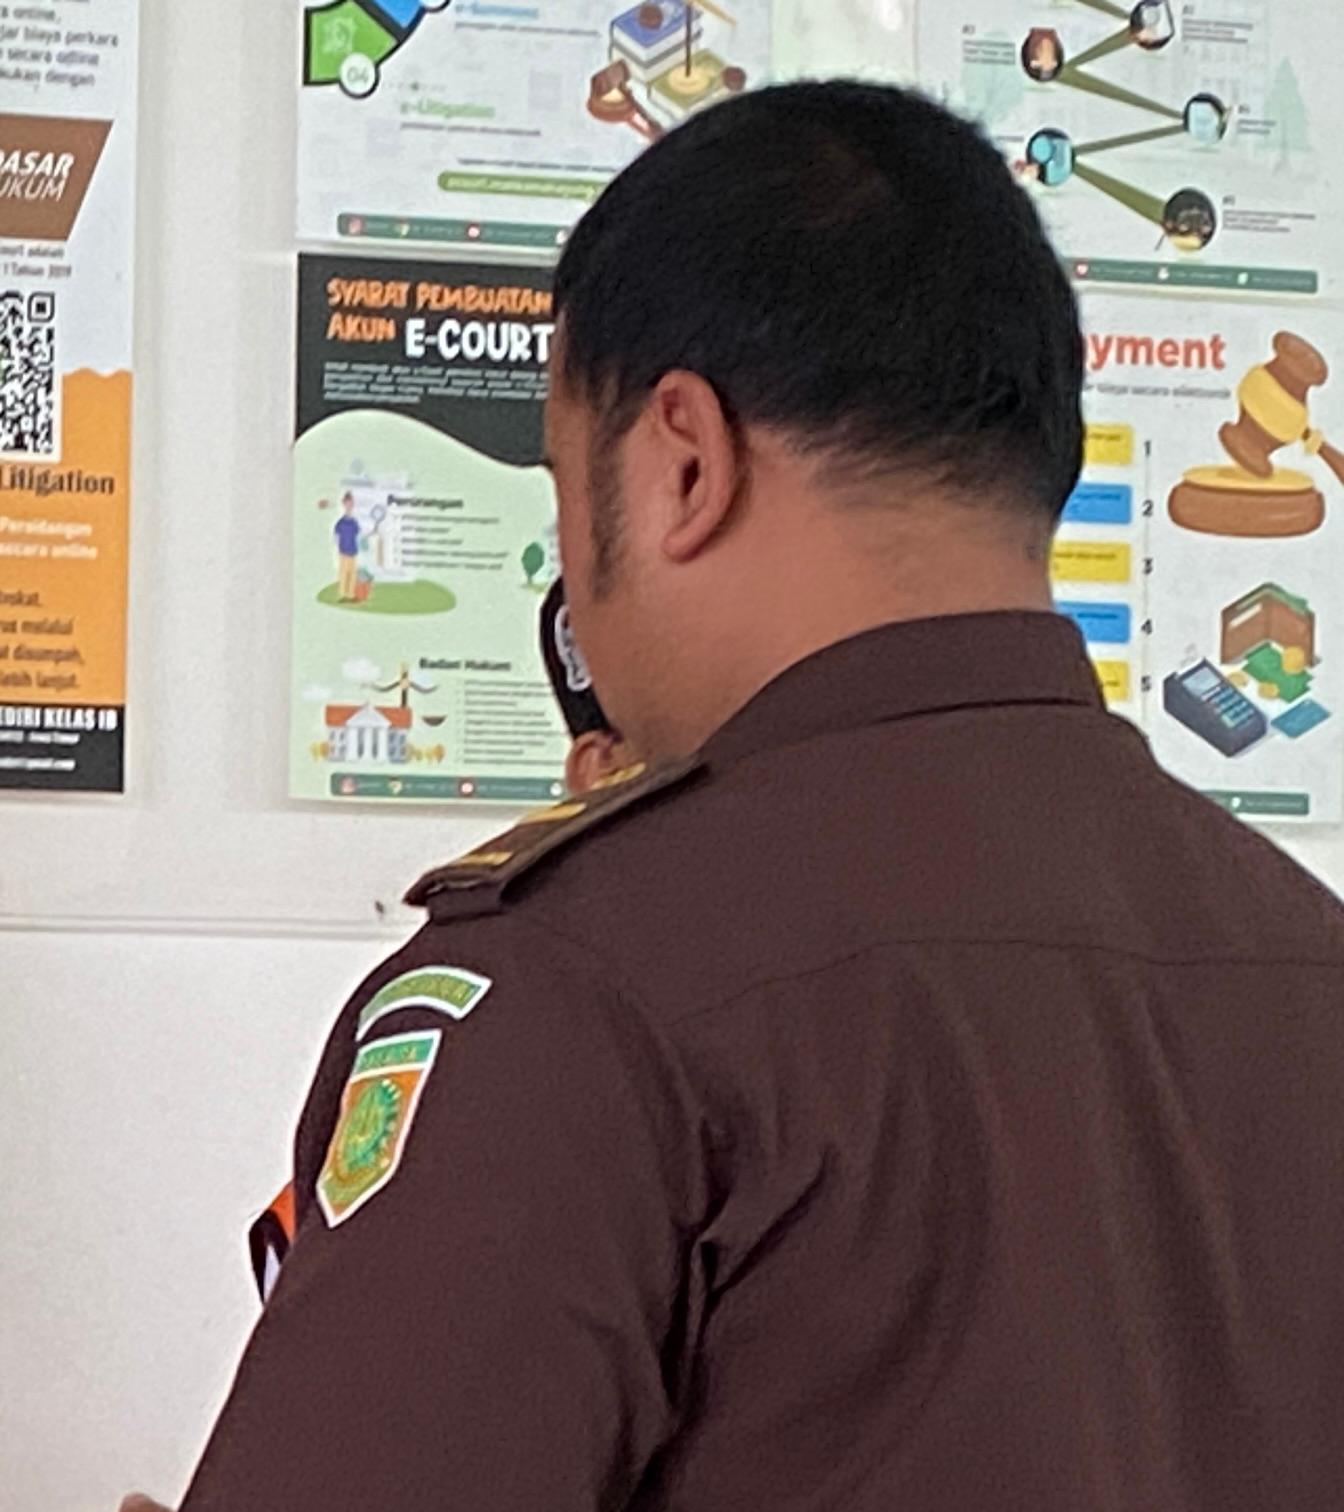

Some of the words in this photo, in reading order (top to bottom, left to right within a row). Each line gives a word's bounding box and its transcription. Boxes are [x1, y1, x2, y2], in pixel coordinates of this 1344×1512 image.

[326, 277, 411, 309] SYARAT
[415, 281, 554, 315] PEMBUATAN
[325, 311, 397, 342] AKUN
[405, 318, 556, 364] E-COURT
[1088, 332, 1227, 371] yment
[1143, 441, 1152, 457] 1
[1142, 499, 1155, 518] 2
[1142, 557, 1154, 575] 3
[1140, 618, 1153, 635] 4
[42, 707, 96, 730] KELAS
